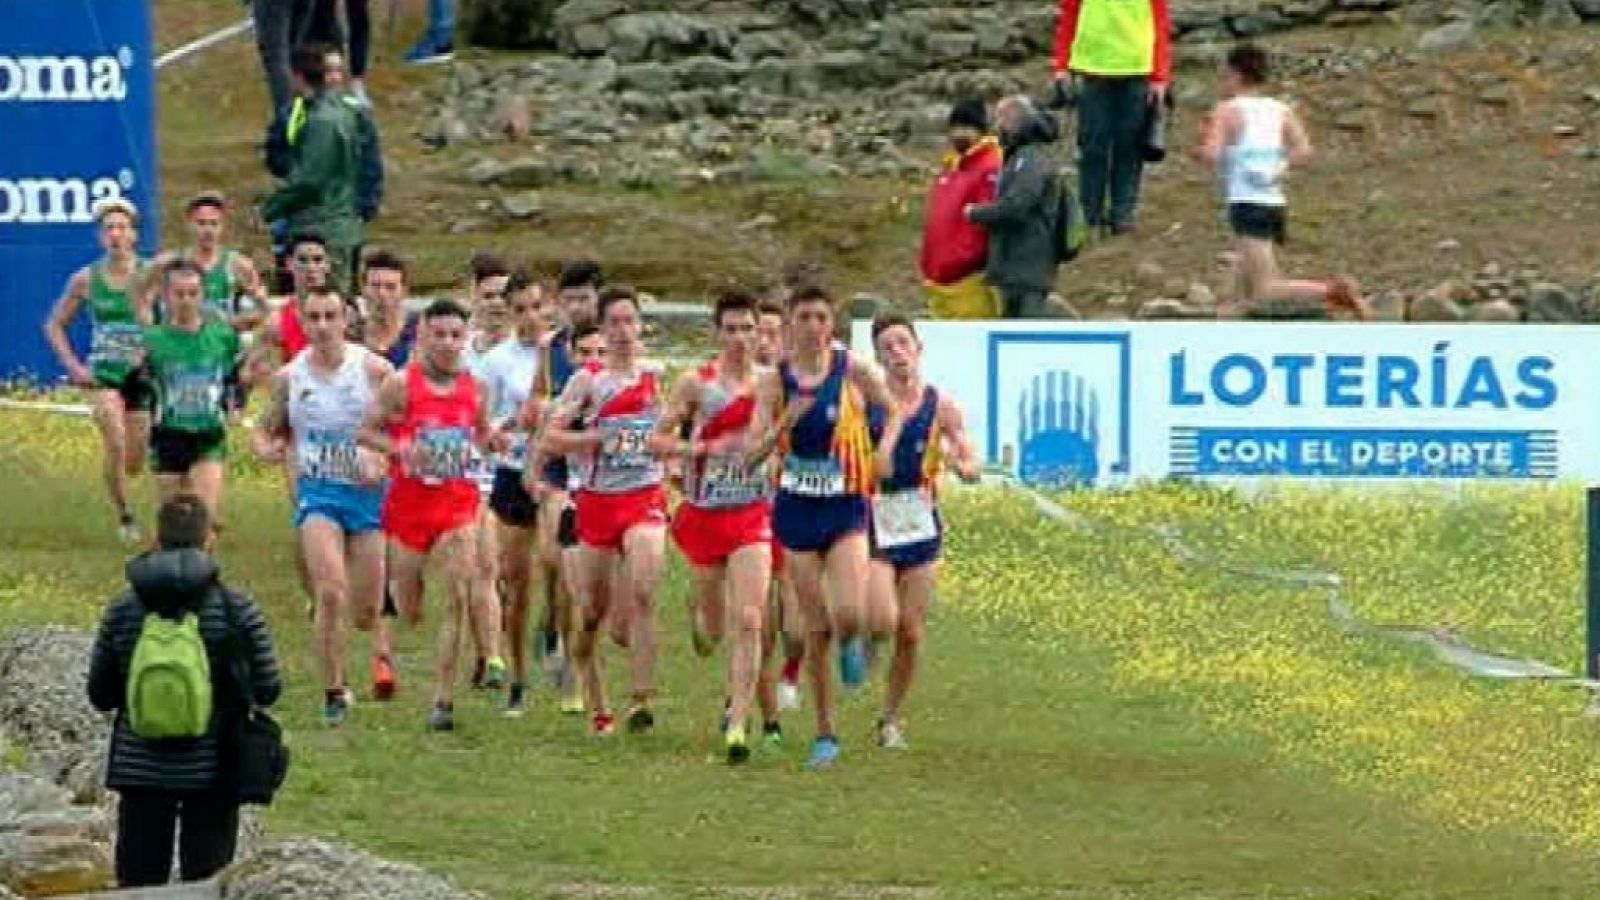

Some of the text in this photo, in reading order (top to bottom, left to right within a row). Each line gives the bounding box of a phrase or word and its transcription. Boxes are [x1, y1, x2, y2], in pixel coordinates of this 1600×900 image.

[1169, 341, 1558, 409] LOTERÍAS
[1211, 438, 1513, 465] CON EL DEPORTE
